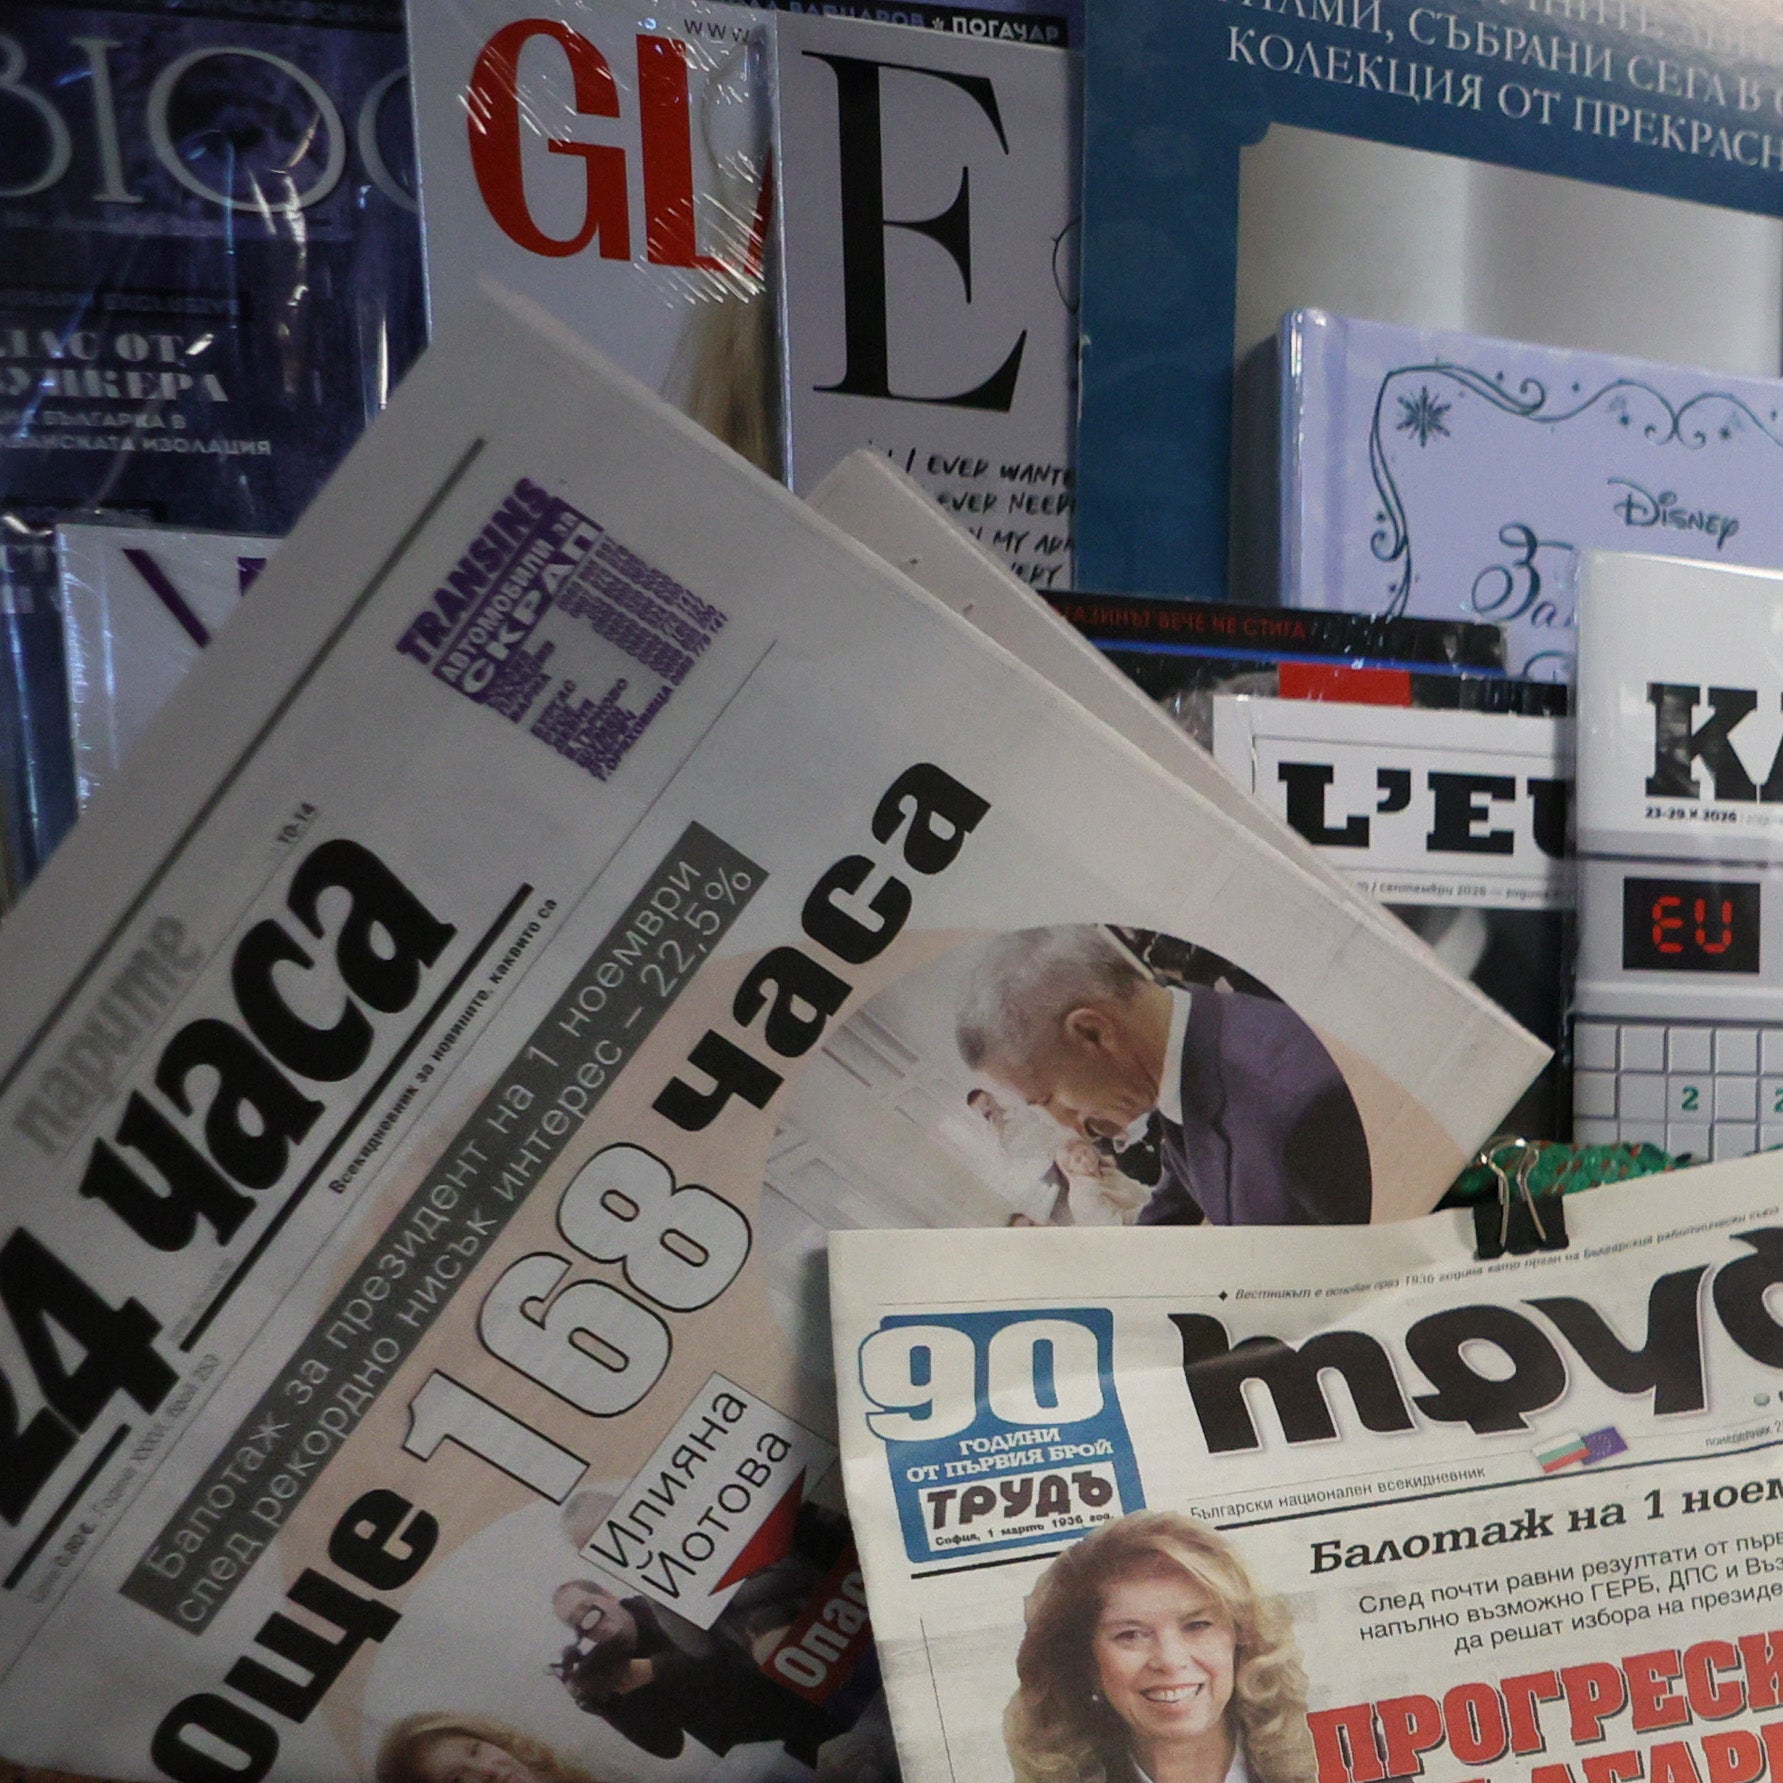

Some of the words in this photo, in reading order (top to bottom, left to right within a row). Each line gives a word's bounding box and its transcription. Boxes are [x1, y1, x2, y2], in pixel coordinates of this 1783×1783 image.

[952, 15, 1059, 43] ПОГАЧАР
[1227, 26, 1484, 111] КОЛЕКЦИЯ
[1498, 81, 1562, 125] ОТ
[1408, 11, 1613, 83] СЪБРАНИ
[468, 18, 773, 277] GL
[394, 474, 553, 669] TRANSINS
[438, 536, 555, 682] АВТОМОБИЛИ
[457, 518, 601, 699] СКРАП
[1651, 894, 1734, 955] EU
[78, 838, 457, 1253] часа
[327, 1080, 422, 1198] Всекидневник
[413, 1061, 437, 1086] за
[402, 1141, 752, 1505] 168
[652, 758, 985, 1132] часа
[143, 1404, 294, 1587] Балотаж
[279, 1354, 331, 1409] за
[319, 1136, 499, 1357] президент
[482, 1079, 535, 1136] на
[526, 1042, 562, 1075] 1
[554, 856, 708, 1044] ноември
[170, 1522, 263, 1629] след
[247, 1329, 410, 1528] рекордно
[391, 1203, 498, 1331] нисък
[486, 1032, 628, 1205] интерес
[636, 857, 758, 1001] 22,5%
[850, 1302, 1114, 1450] 90
[959, 1426, 1061, 1456] ГОДИНИ
[590, 1378, 751, 1572] Илияна
[638, 1418, 795, 1604] Йотова
[905, 1464, 942, 1484] ОТ
[943, 1448, 1047, 1478] ПЪРВИЯ
[1047, 1435, 1114, 1462] БРОЙ
[923, 1466, 1116, 1532] ТРУДЪ
[1277, 1479, 1374, 1509] национален
[1376, 1463, 1486, 1494] всекидневник
[1304, 1505, 1558, 1576] Балотаж
[1564, 1499, 1627, 1534] на
[1642, 1488, 1667, 1521] 1
[1356, 1586, 1425, 1619] След
[1430, 1577, 1500, 1605] почти
[1505, 1564, 1576, 1595] равни
[1580, 1544, 1700, 1583] резултати
[1703, 1539, 1731, 1559] от
